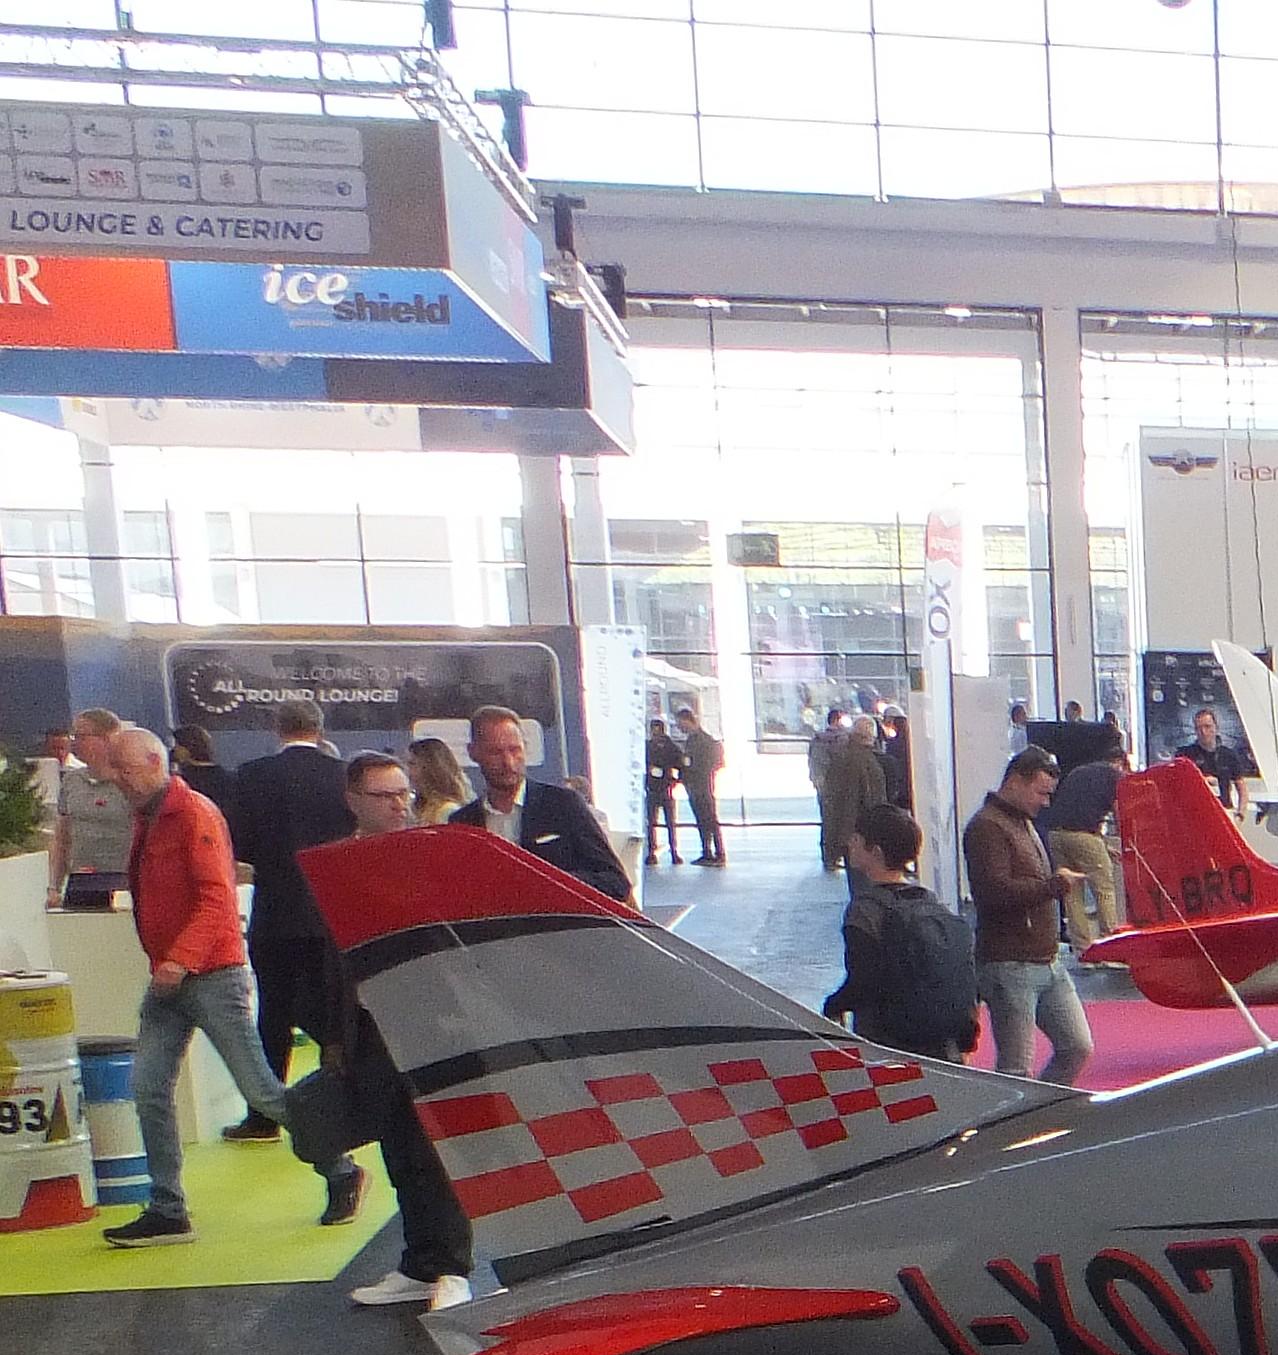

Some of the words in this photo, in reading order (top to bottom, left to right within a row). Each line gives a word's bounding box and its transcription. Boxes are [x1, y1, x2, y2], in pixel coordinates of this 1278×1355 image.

[10, 210, 137, 235] LOUNGE
[147, 216, 164, 236] &
[175, 216, 324, 242] CATERING
[0, 254, 50, 306] R
[264, 264, 348, 305] ice
[334, 293, 450, 326] shield
[213, 680, 245, 694] ALL
[271, 667, 361, 681] WELCOME
[395, 668, 427, 682] THE
[246, 689, 314, 702] ROUND
[320, 690, 399, 703] LOUNGE!
